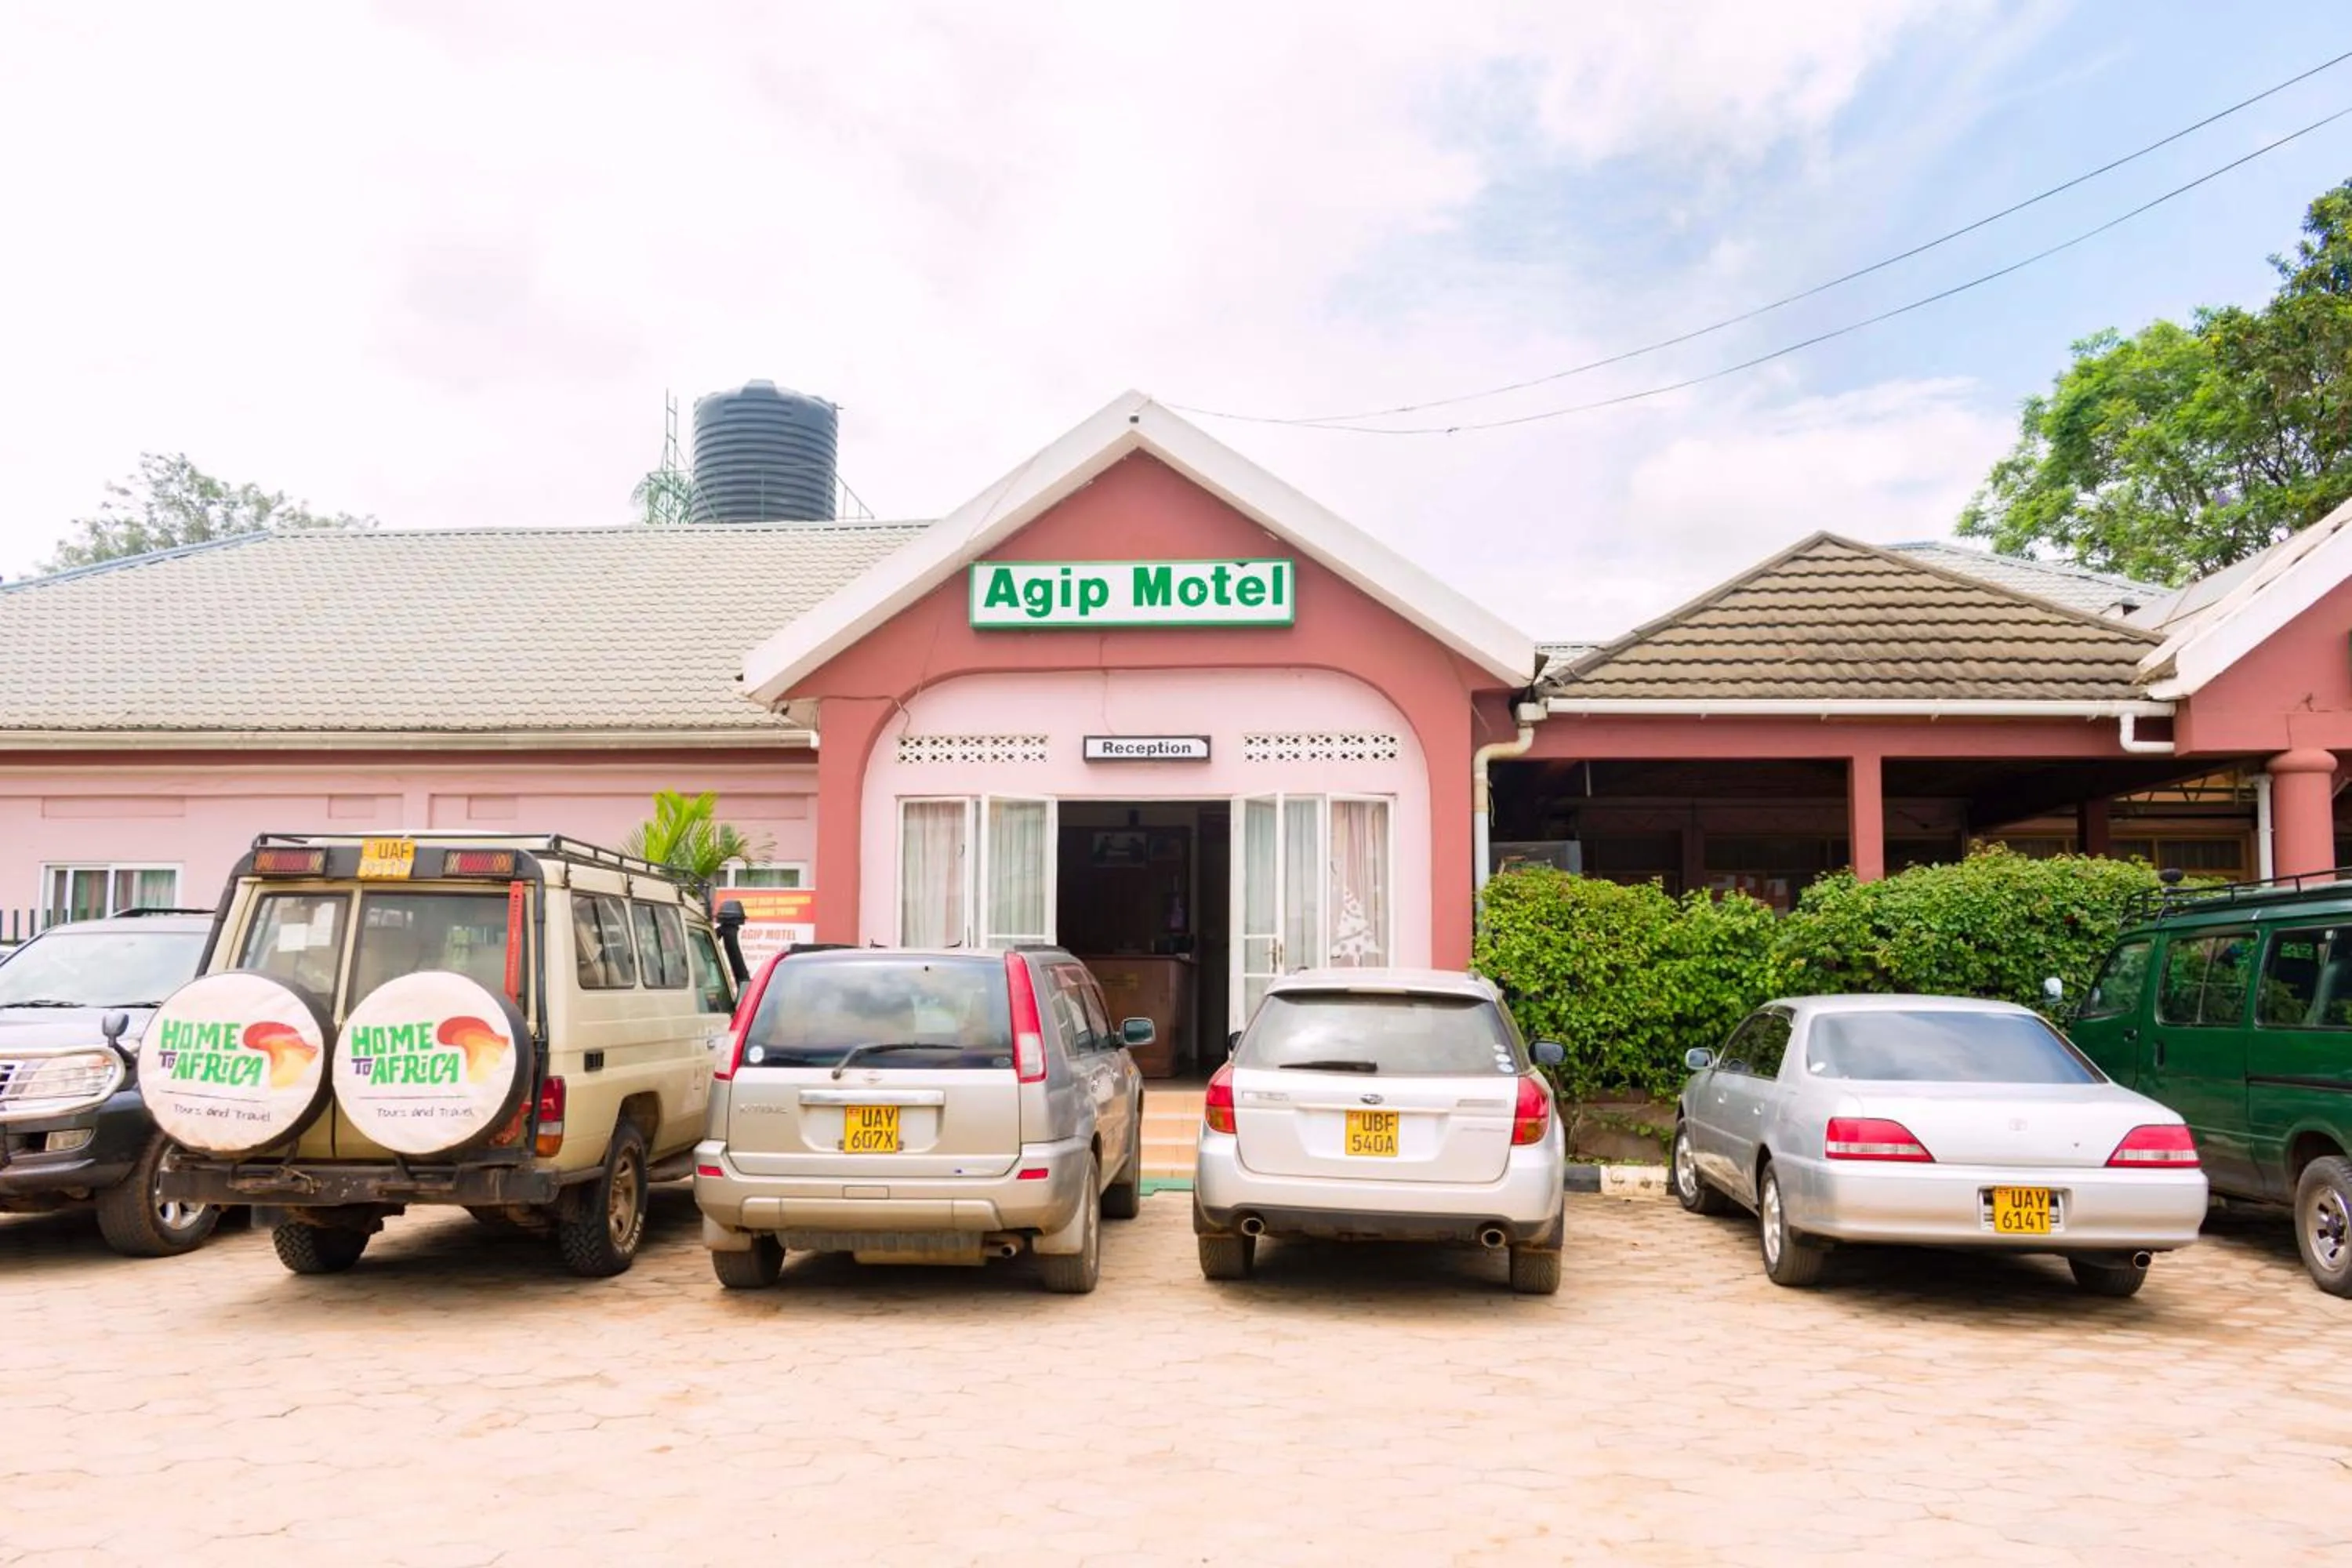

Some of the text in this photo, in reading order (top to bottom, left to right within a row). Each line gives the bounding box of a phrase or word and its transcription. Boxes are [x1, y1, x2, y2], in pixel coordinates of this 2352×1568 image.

[984, 566, 1284, 618] Agip Motel
[1102, 741, 1192, 757] Reception
[378, 842, 412, 860] UAF
[765, 928, 797, 941] MOTEL
[161, 1018, 241, 1051] HOME
[351, 1022, 434, 1057] HOME
[206, 1107, 230, 1118] and
[235, 1110, 270, 1122] Travel
[411, 1106, 434, 1117] and
[862, 1106, 895, 1127] UAY
[1362, 1112, 1396, 1132] UBF
[851, 1130, 894, 1149] 607X
[1352, 1134, 1395, 1152] 540A
[2011, 1190, 2045, 1208] UAY
[2002, 1210, 2045, 1229] 614T
